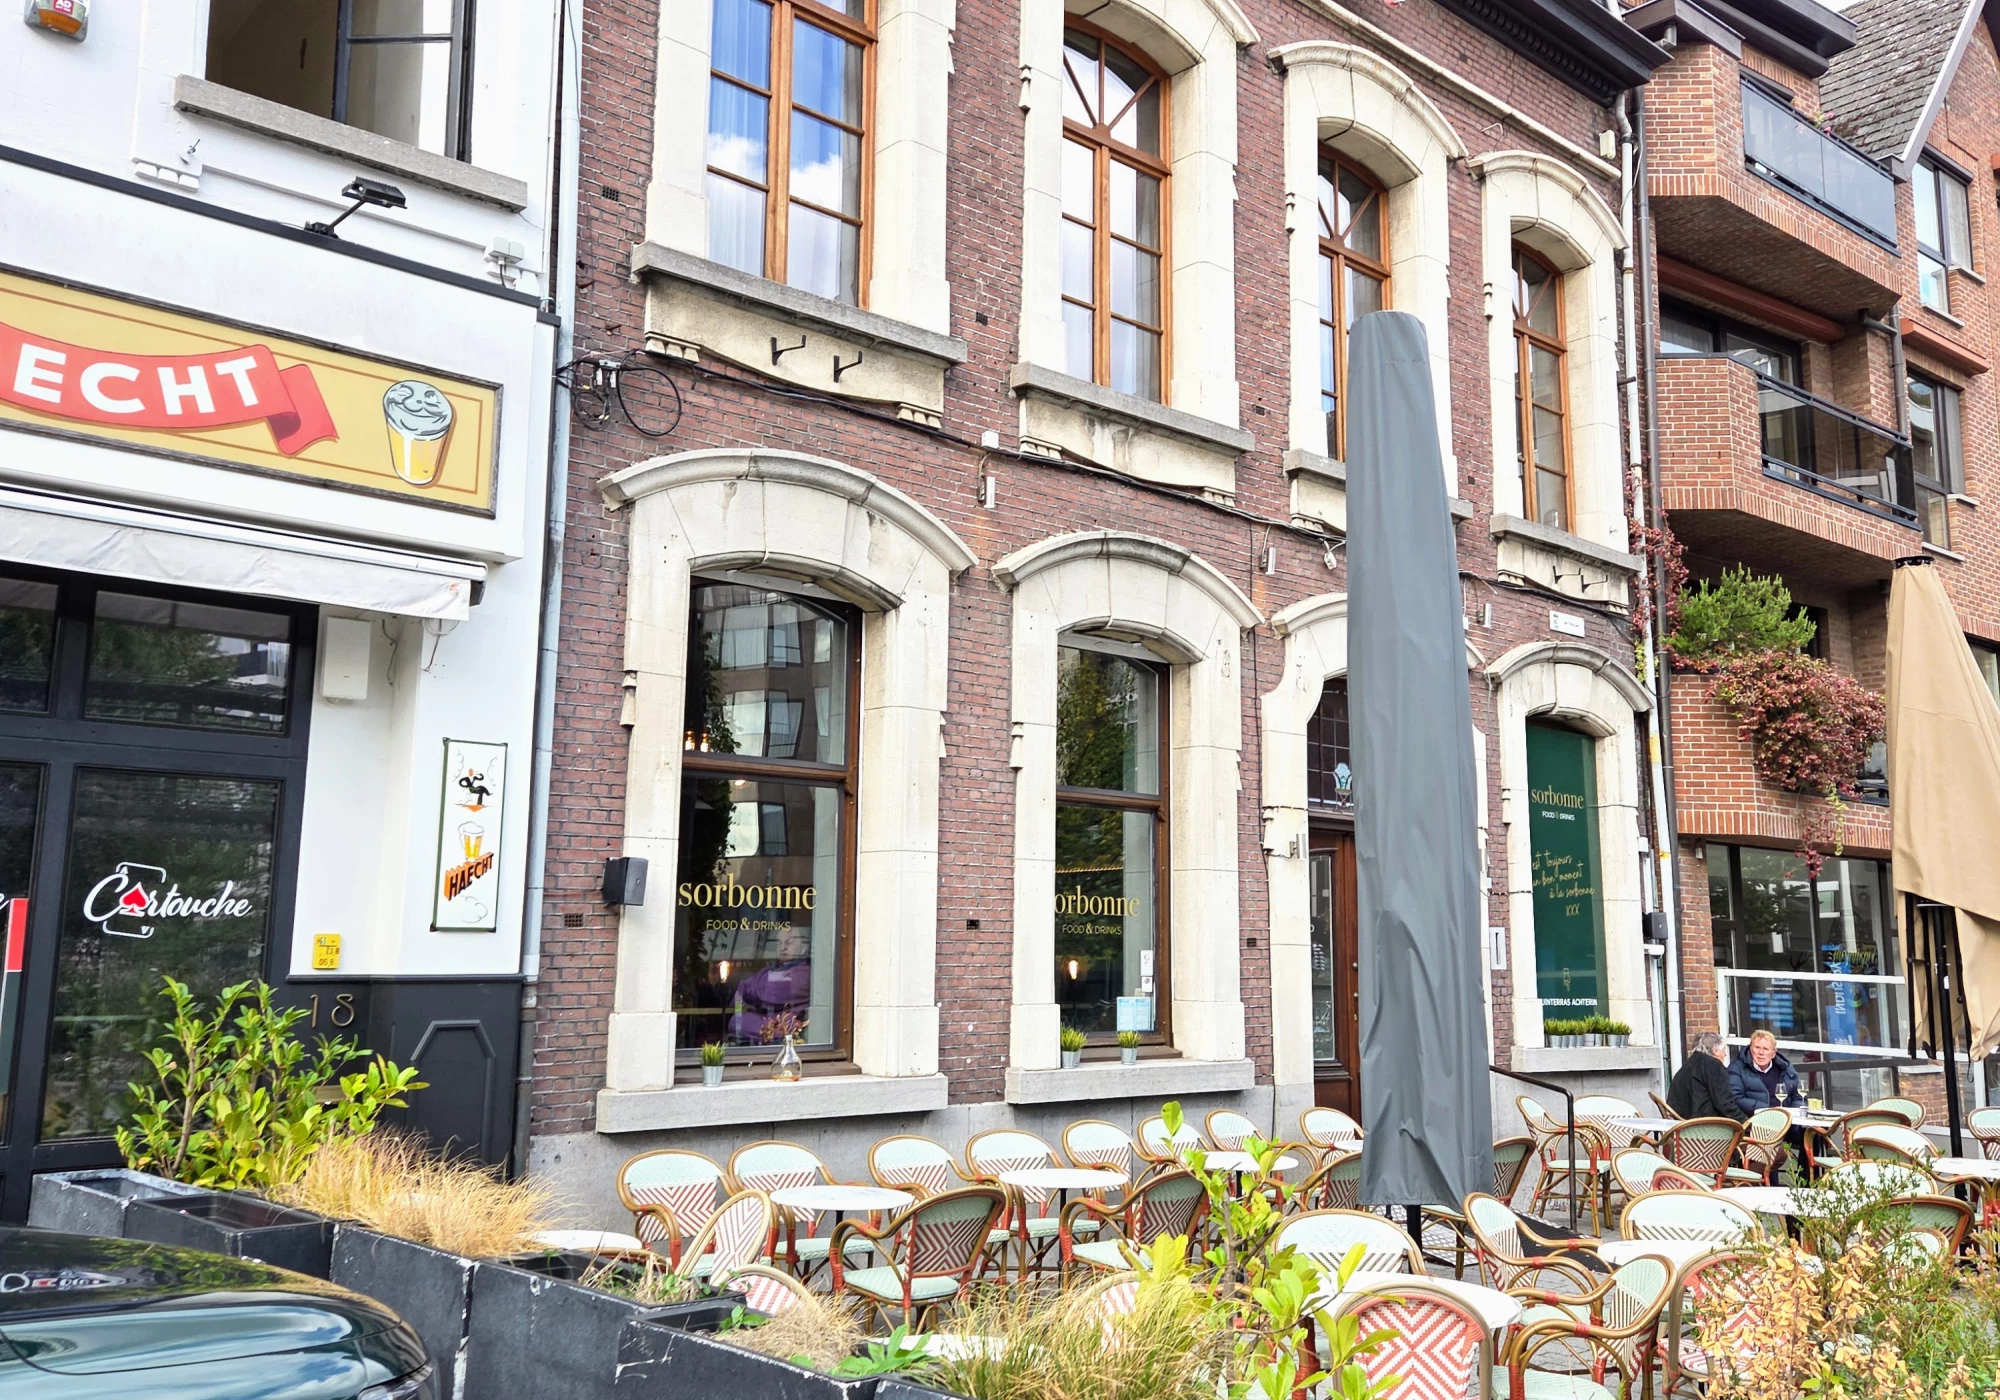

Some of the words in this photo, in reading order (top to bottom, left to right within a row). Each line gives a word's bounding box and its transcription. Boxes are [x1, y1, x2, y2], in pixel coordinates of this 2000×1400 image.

[13, 343, 259, 415] ECHT
[1531, 785, 1584, 809] sorbonne
[1542, 811, 1555, 819] FOOD
[1560, 813, 1575, 821] DRINKS
[446, 852, 494, 901] HAECHT
[678, 872, 817, 910] sorbonne
[1054, 885, 1141, 917] orbonne
[706, 919, 738, 931] FOOD
[740, 917, 750, 931] &
[753, 920, 791, 931] DRINKS
[1062, 924, 1084, 934] FOOD
[1085, 922, 1093, 934] &
[1094, 925, 1122, 935] DRINKS
[310, 993, 355, 1027] 18
